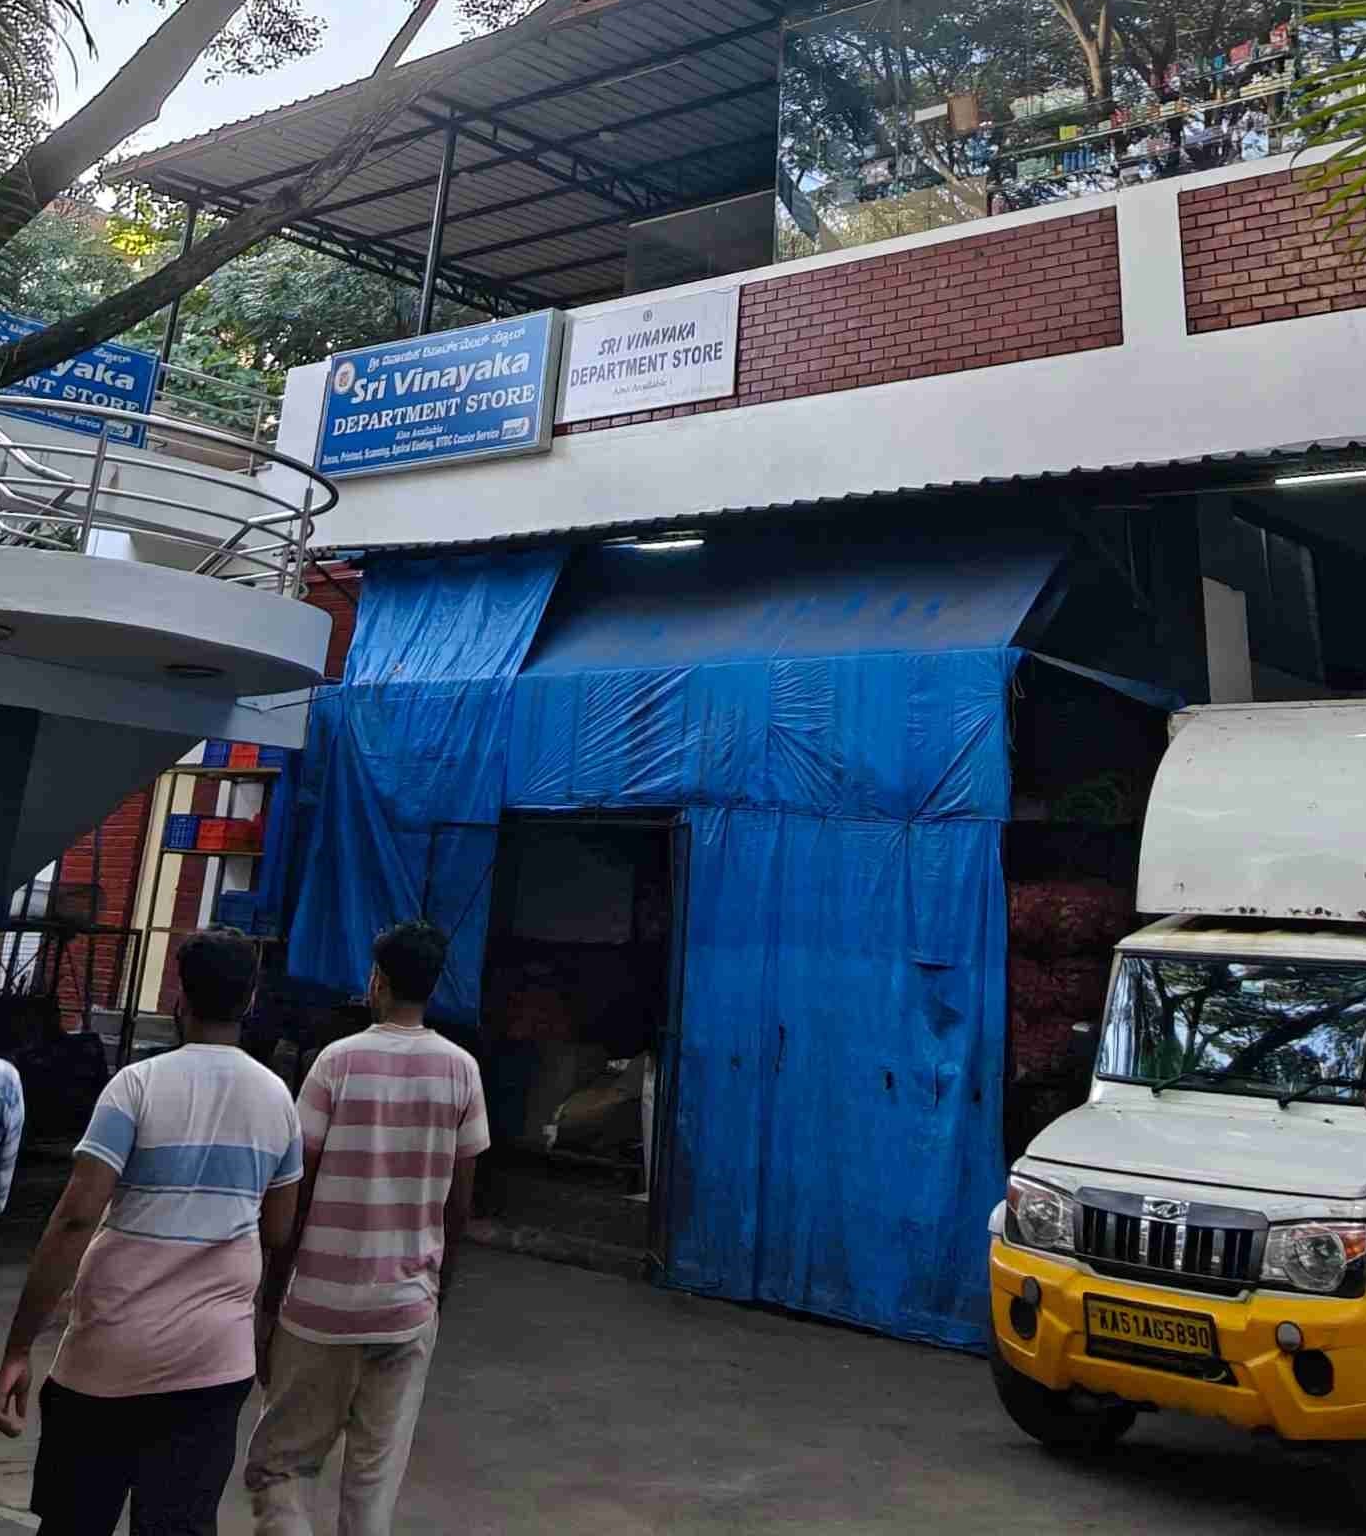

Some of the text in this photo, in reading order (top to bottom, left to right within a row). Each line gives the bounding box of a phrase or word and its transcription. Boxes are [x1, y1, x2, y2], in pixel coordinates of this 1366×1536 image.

[598, 320, 696, 356] SRI VINAYAKA
[50, 359, 136, 390] yaka
[350, 351, 530, 404] Sri Vinayaka
[570, 341, 724, 387] DEPARTMENT STORE
[62, 385, 140, 411] STORE
[332, 397, 461, 436] DEPARTMENT
[465, 384, 536, 413] STORE
